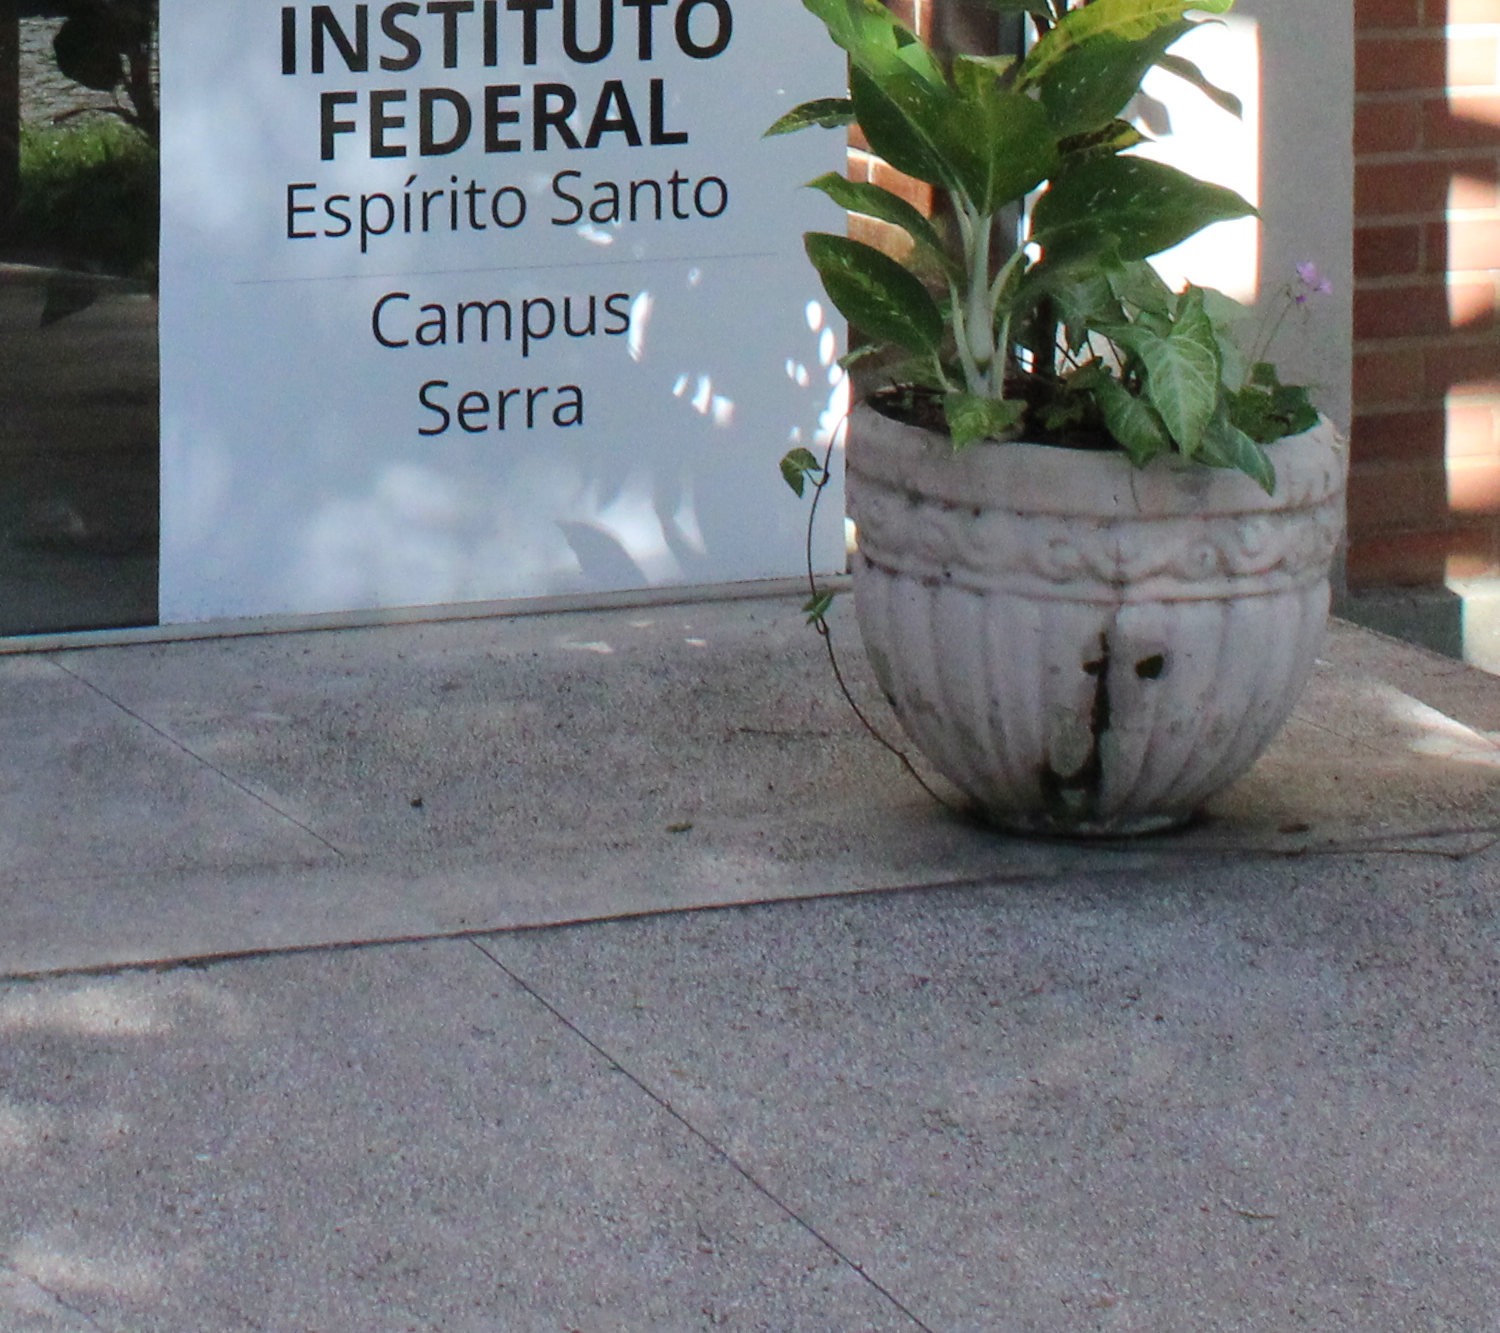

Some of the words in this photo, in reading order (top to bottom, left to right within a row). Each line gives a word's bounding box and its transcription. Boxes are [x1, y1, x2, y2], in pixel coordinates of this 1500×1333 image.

[321, 79, 688, 160] FEDERAL
[288, 175, 526, 253] Espírito
[552, 170, 727, 225] Santo
[373, 293, 631, 357] Campus
[419, 381, 582, 435] Serra
